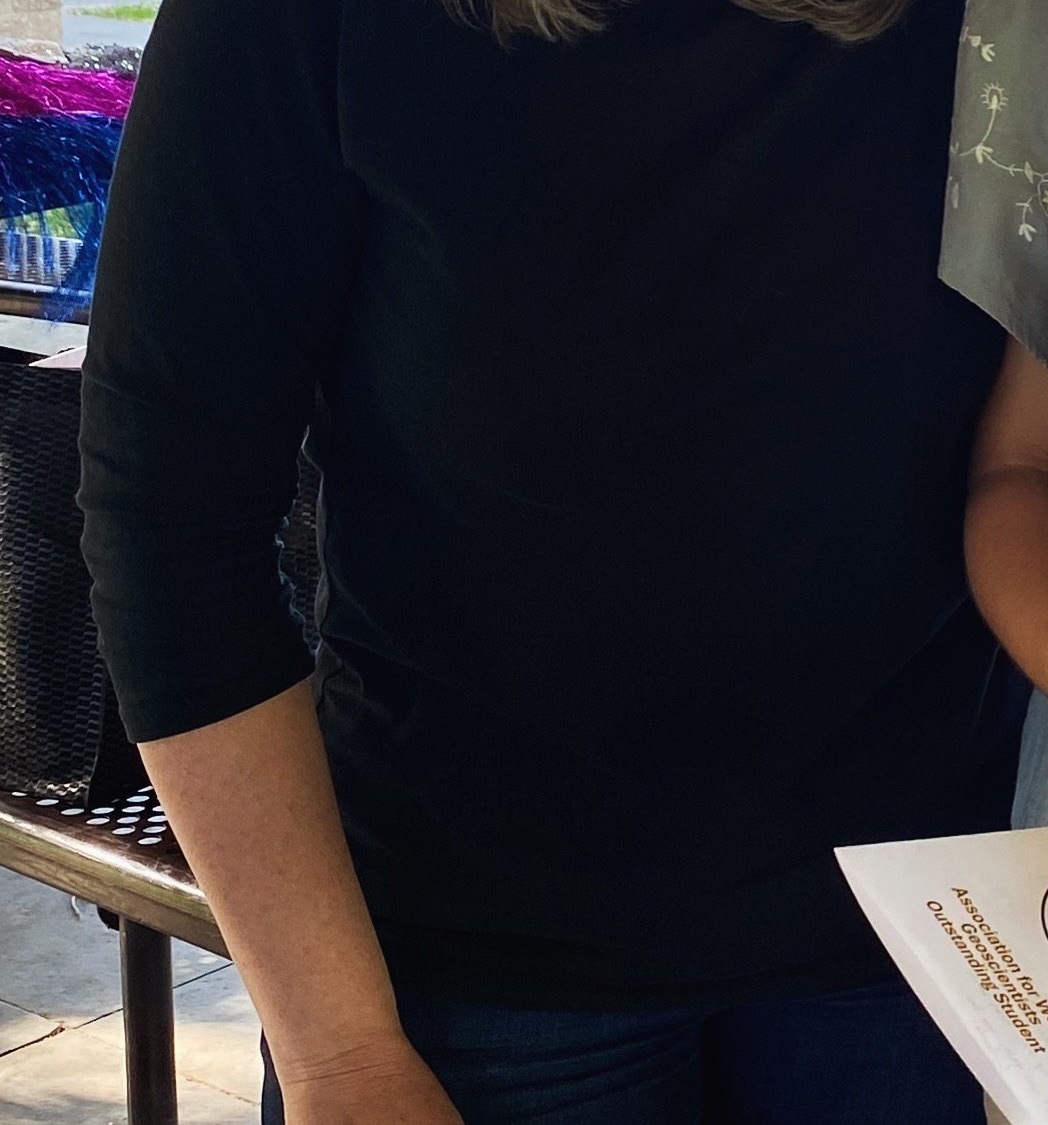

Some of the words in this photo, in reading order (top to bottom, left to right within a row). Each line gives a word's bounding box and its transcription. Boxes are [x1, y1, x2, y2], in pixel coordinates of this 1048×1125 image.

[926, 900, 1000, 992] Outstanding
[993, 992, 1046, 1054] Student
[951, 887, 1022, 974] Association
[1016, 975, 1040, 998] for
[961, 923, 1042, 1026] Geoscientists
